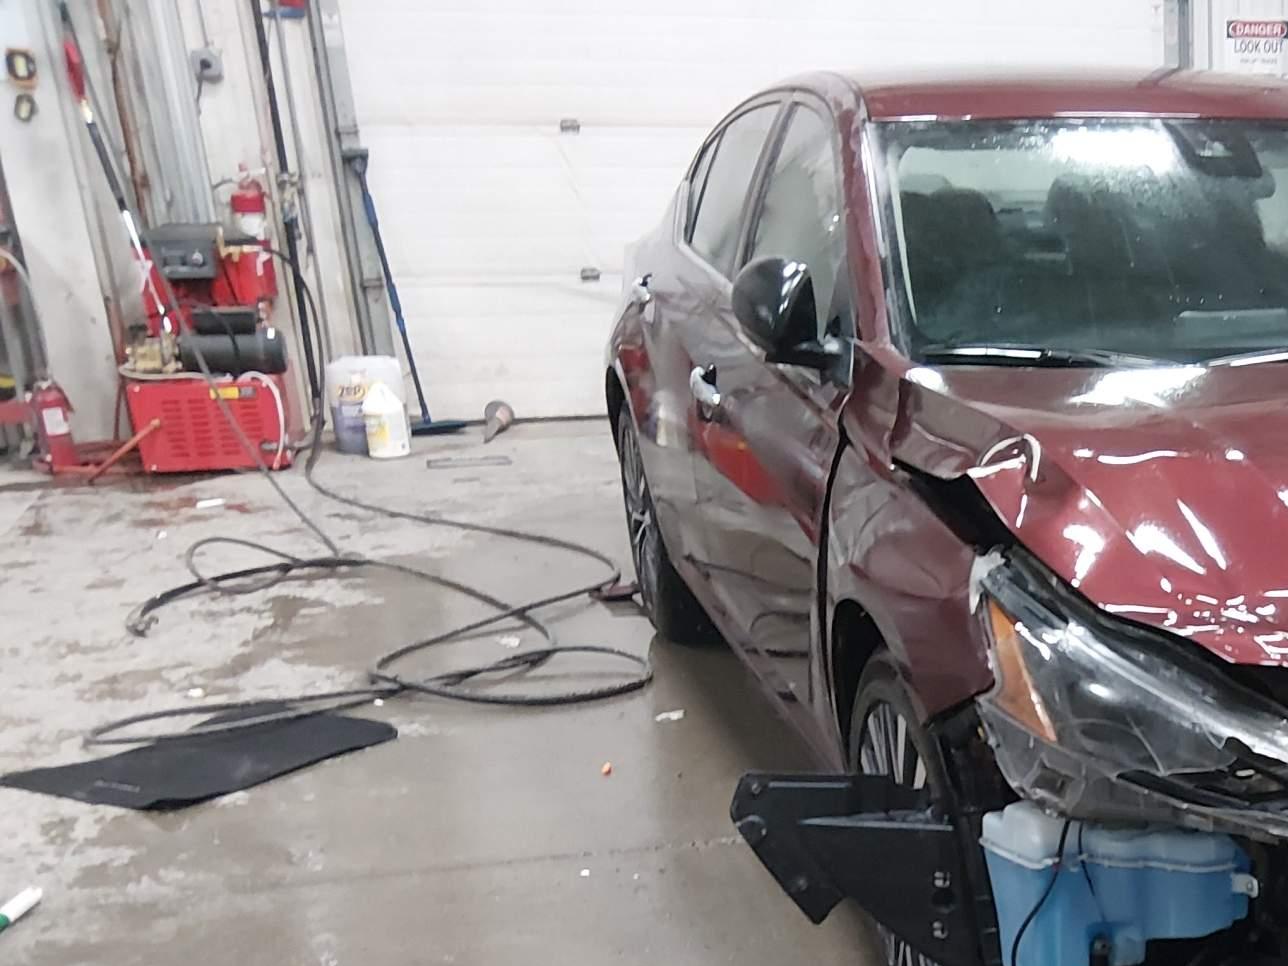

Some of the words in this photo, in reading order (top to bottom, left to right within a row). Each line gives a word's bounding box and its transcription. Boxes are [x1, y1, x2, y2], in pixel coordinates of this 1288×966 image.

[1236, 23, 1282, 36] DANGER
[1234, 40, 1260, 53] LOOK
[1264, 40, 1283, 53] OUT
